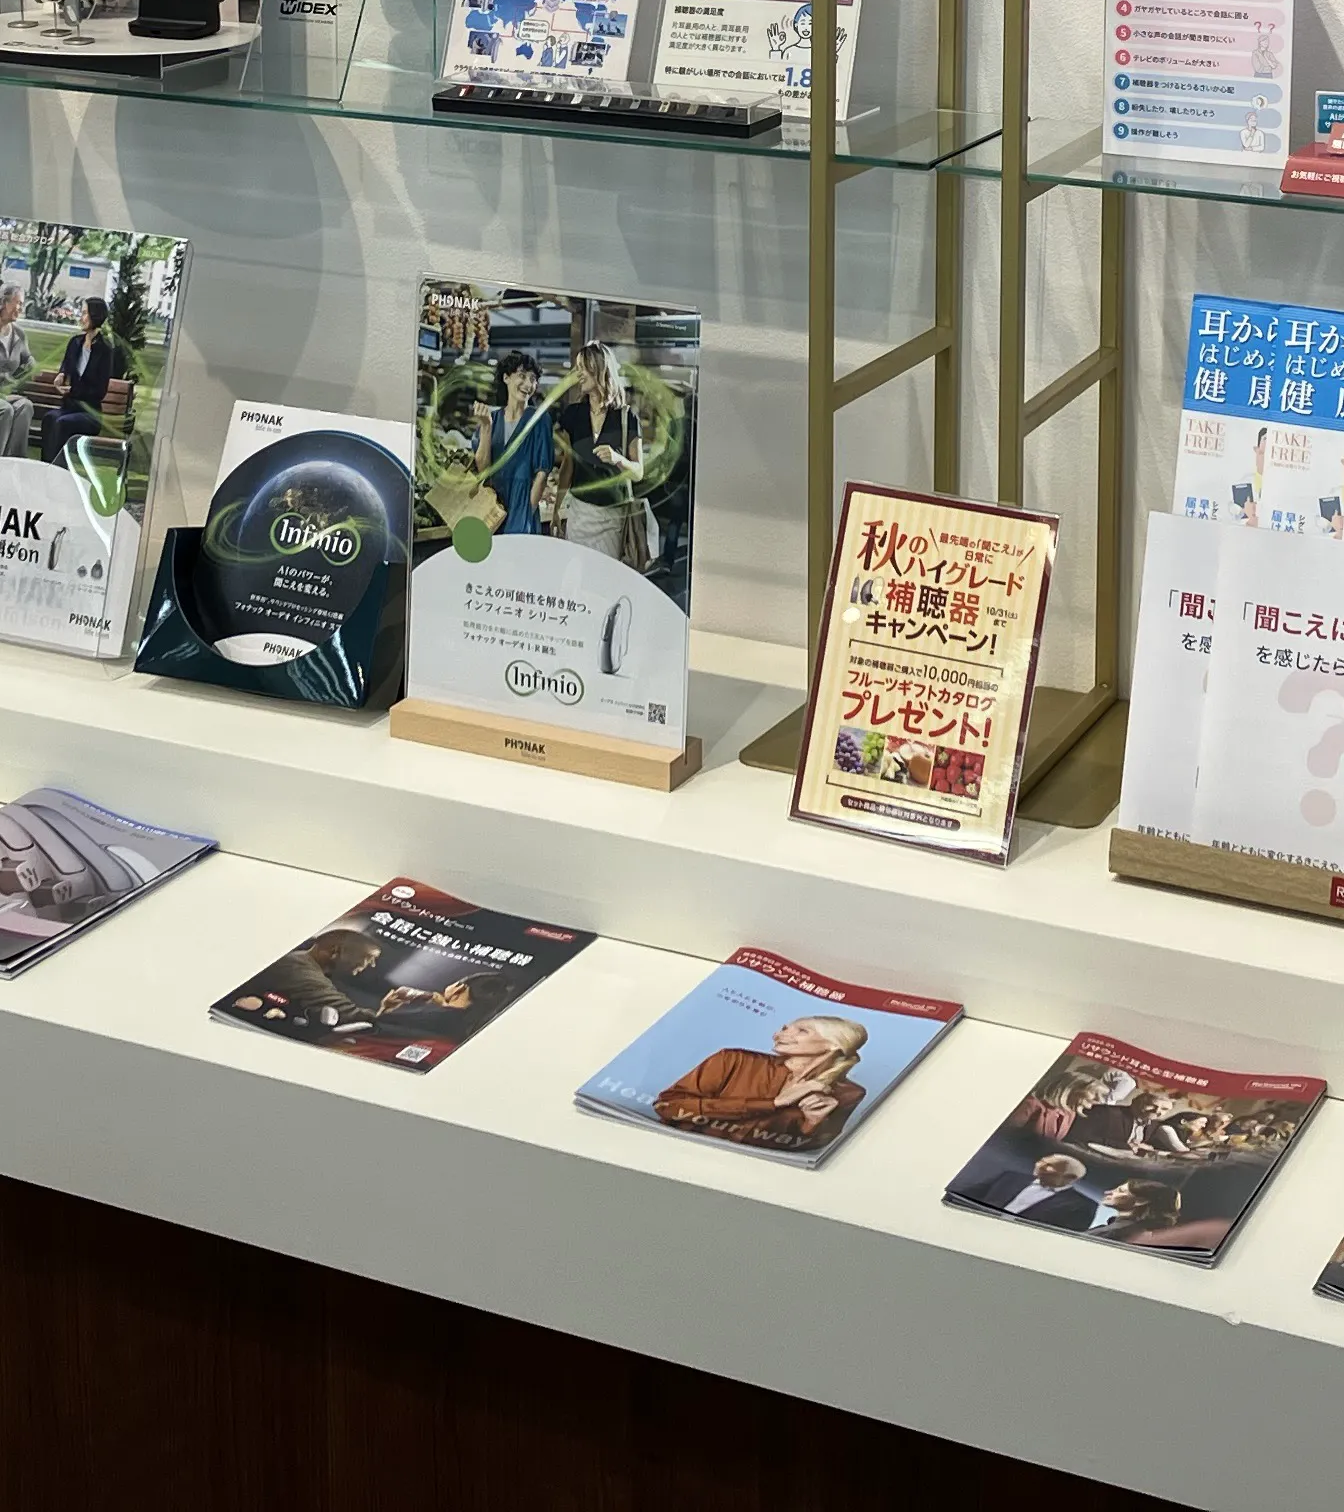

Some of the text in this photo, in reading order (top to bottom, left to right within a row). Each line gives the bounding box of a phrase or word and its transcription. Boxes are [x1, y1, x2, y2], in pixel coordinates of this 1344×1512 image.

[674, 5, 725, 16] 補聴器の満足度
[1132, 54, 1221, 68] テレビのボリュームが大きい
[431, 292, 480, 311] PHONAK
[239, 410, 285, 427] PHONAK
[279, 518, 354, 558] Infinio
[855, 518, 930, 577] 秋の
[938, 531, 1025, 558] 最先端の「聞こえ」が
[18, 546, 40, 564] on
[963, 549, 995, 565] 日常に
[902, 555, 1026, 597] ハイグレード
[463, 598, 570, 627] インフィニオ シリーズ
[464, 581, 593, 615] きこえの可能性を解き放つ。
[884, 577, 982, 627] 補聴器
[68, 612, 112, 632] PHONAK
[234, 601, 265, 615] フォナック
[292, 614, 328, 629] インフィニオ
[991, 618, 1009, 629] まで
[462, 630, 526, 651] フォナック オーデオ
[864, 609, 998, 656] キャンペーン！
[512, 664, 579, 698] Infinio
[846, 669, 997, 713] フルーツギフトカタログ
[840, 688, 993, 749] プレゼント！
[370, 911, 534, 966] 会話に強い補聴器
[736, 955, 846, 1002] リサウンド補聴器
[1080, 1042, 1210, 1088] リサウンド耳あな型補聴器
